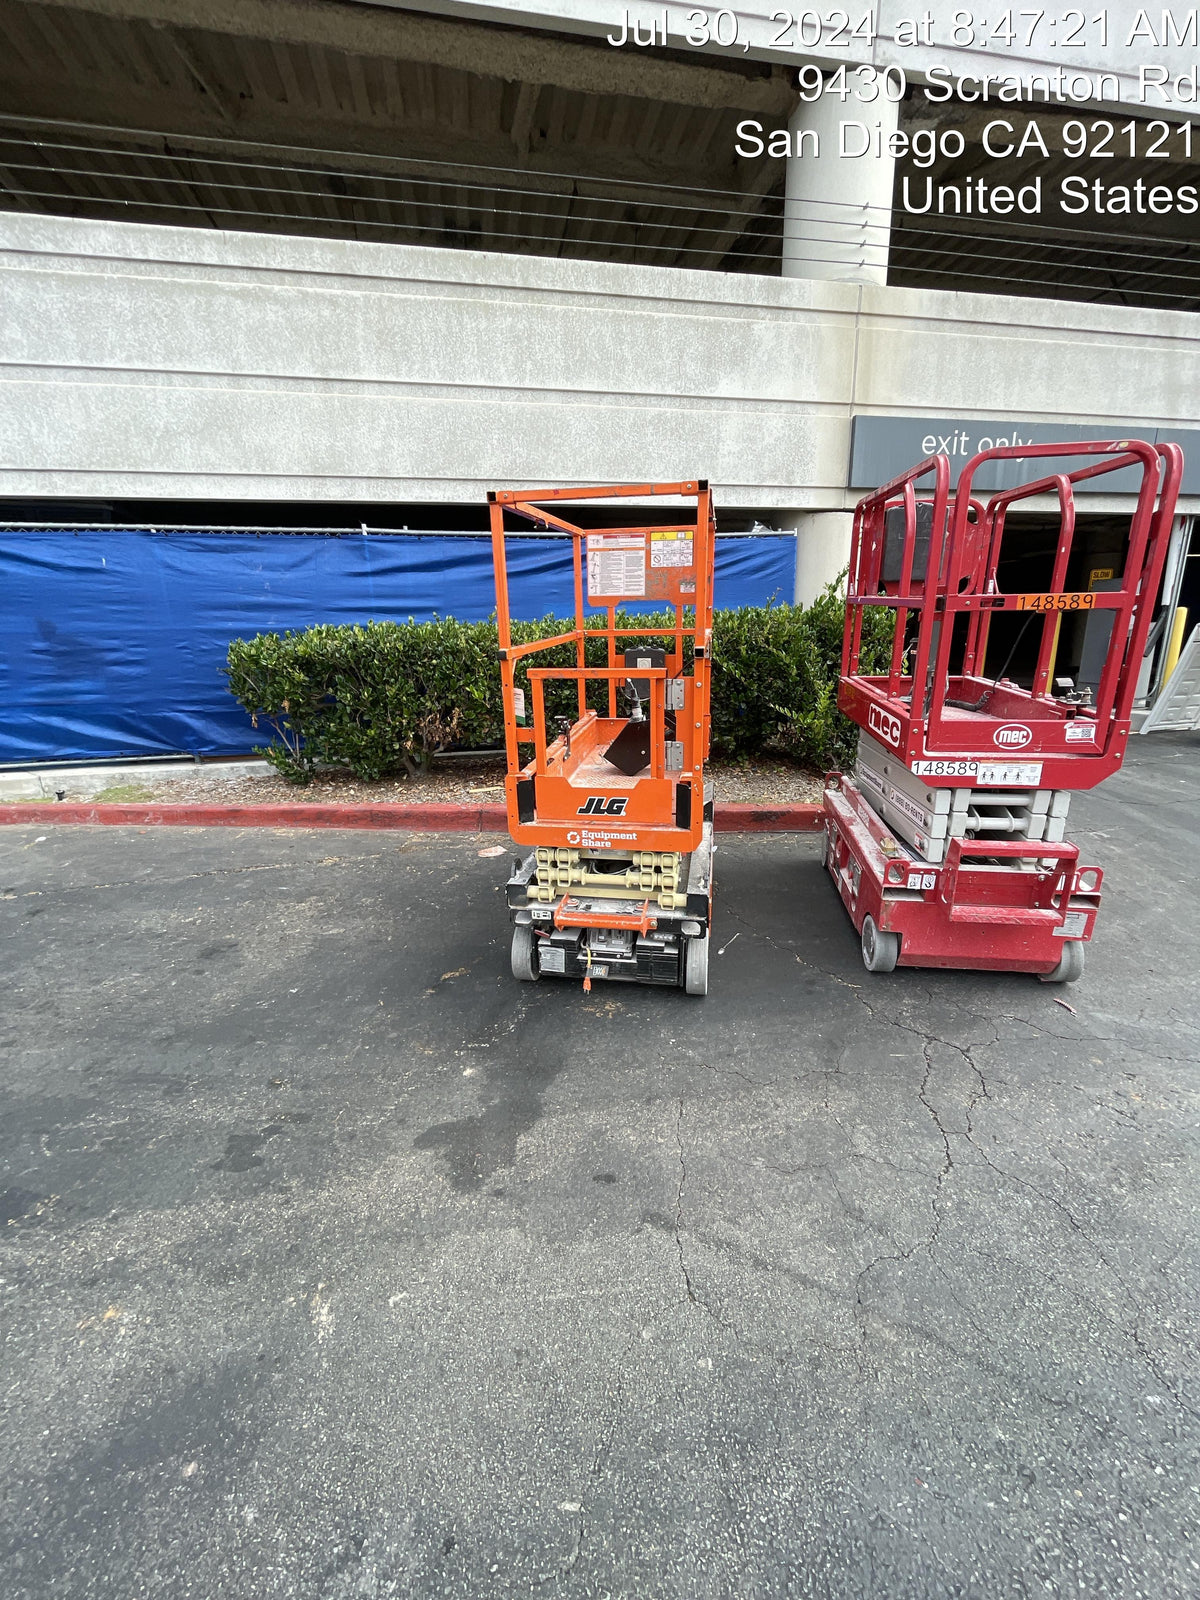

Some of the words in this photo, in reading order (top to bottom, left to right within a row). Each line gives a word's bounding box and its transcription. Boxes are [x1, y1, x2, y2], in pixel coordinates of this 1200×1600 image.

[921, 429, 970, 456] exit
[1092, 571, 1111, 579] SLOW
[1020, 594, 1094, 610] 148589
[912, 761, 979, 776] 148589
[577, 796, 629, 816] JLG
[581, 830, 638, 841] Equipment
[581, 838, 612, 848] Share
